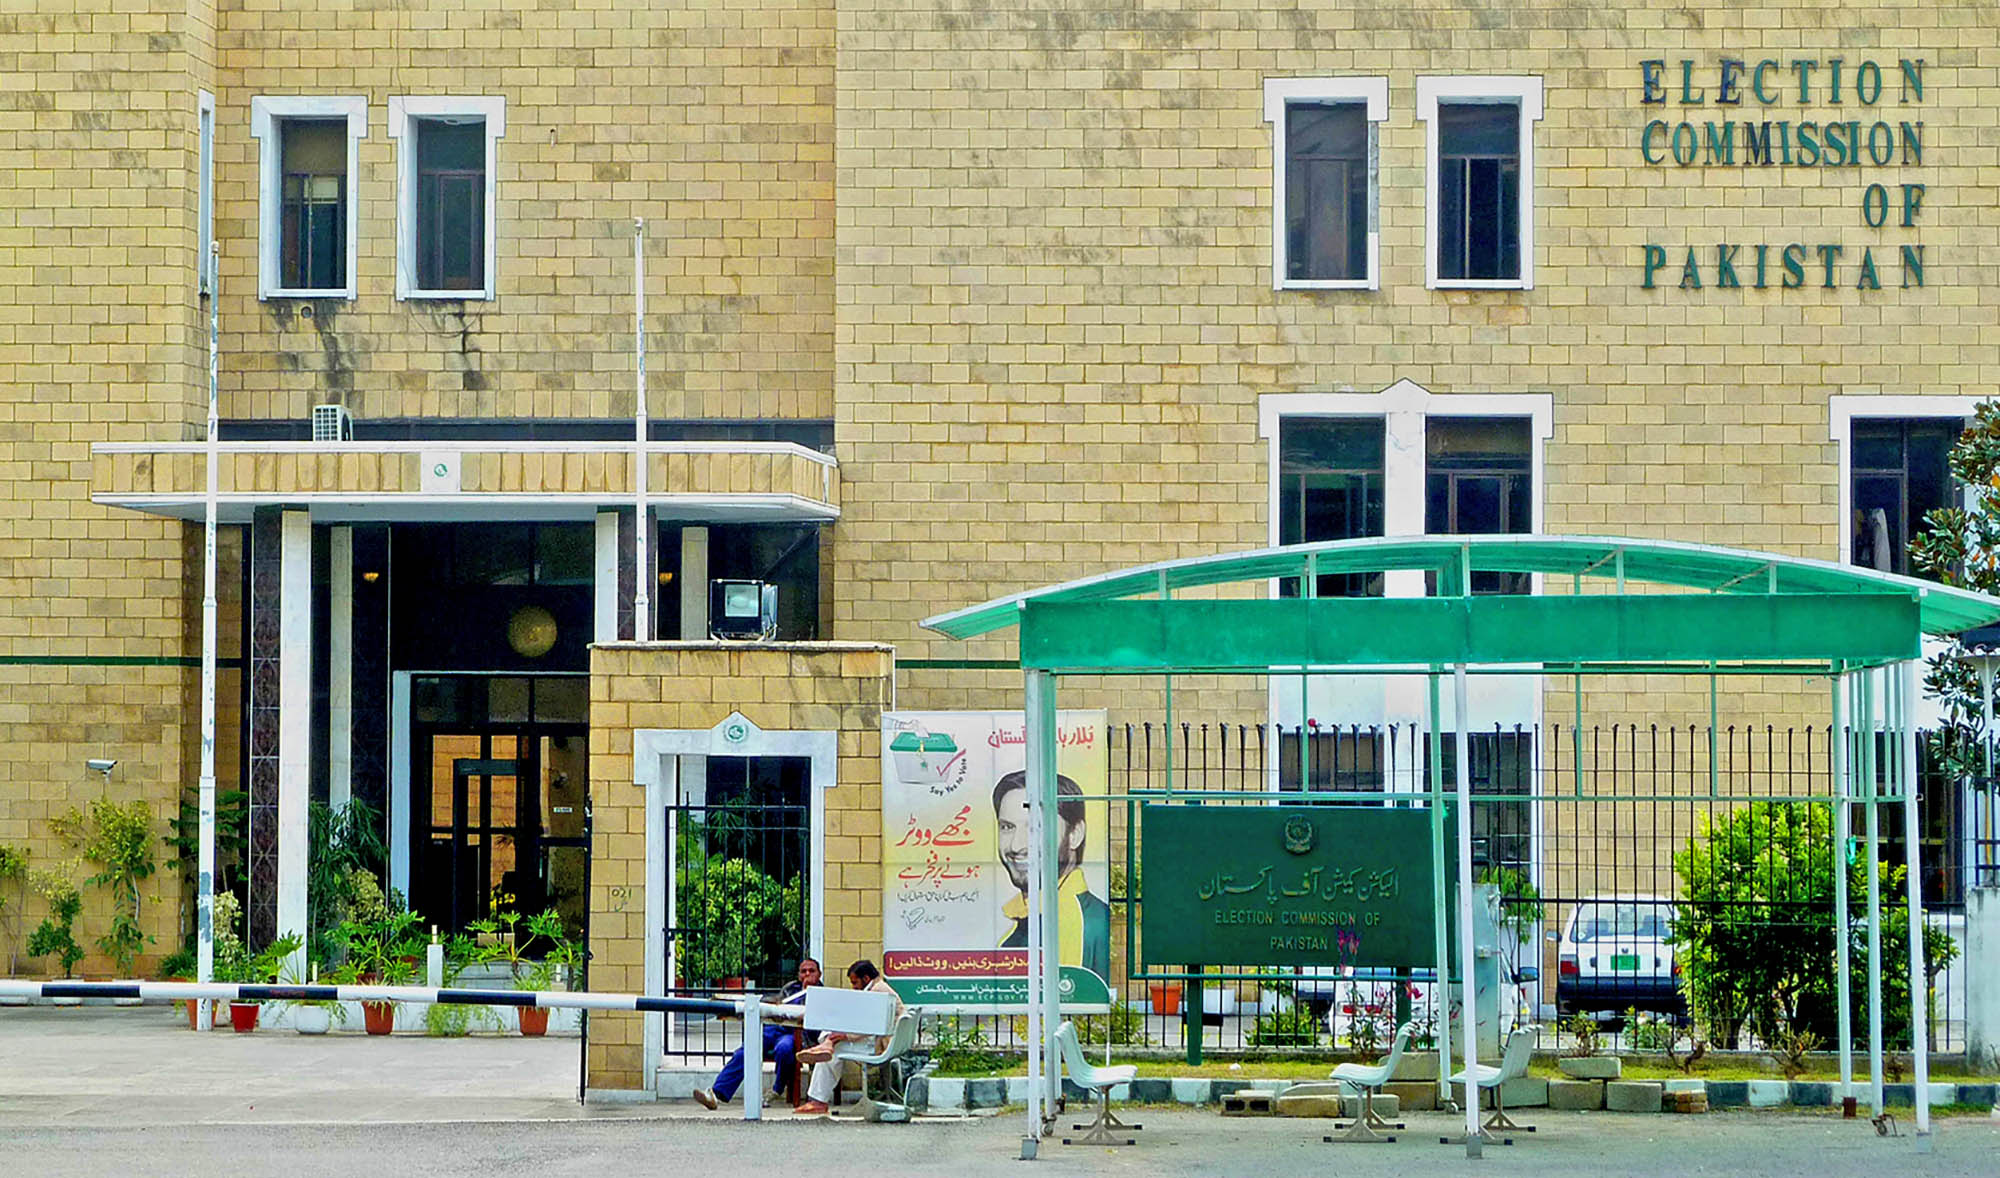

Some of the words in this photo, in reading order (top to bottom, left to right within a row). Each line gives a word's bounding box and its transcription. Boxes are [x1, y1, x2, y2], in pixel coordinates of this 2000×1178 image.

[1639, 59, 1924, 105] ELECTION
[1641, 119, 1924, 166] COMMISSION
[1863, 183, 1925, 228] OF
[1641, 243, 1925, 290] PAKISTAN
[956, 776, 964, 785] to
[958, 758, 967, 775] Vote
[929, 785, 944, 797] Say
[945, 783, 957, 793] Yes
[932, 805, 975, 846] مجھے
[898, 866, 923, 888] ہے
[915, 850, 938, 887] فخر
[940, 857, 981, 880] ہونے
[1281, 866, 1325, 896] آف
[1322, 866, 1363, 901] کمیشن
[1357, 866, 1399, 902] الیکشن
[1198, 865, 1277, 905] پاکستان
[1215, 910, 1273, 925] ELECTION
[1281, 910, 1356, 926] COMMISSION
[1365, 911, 1380, 926] OF
[1270, 936, 1328, 950] PAKISTAN
